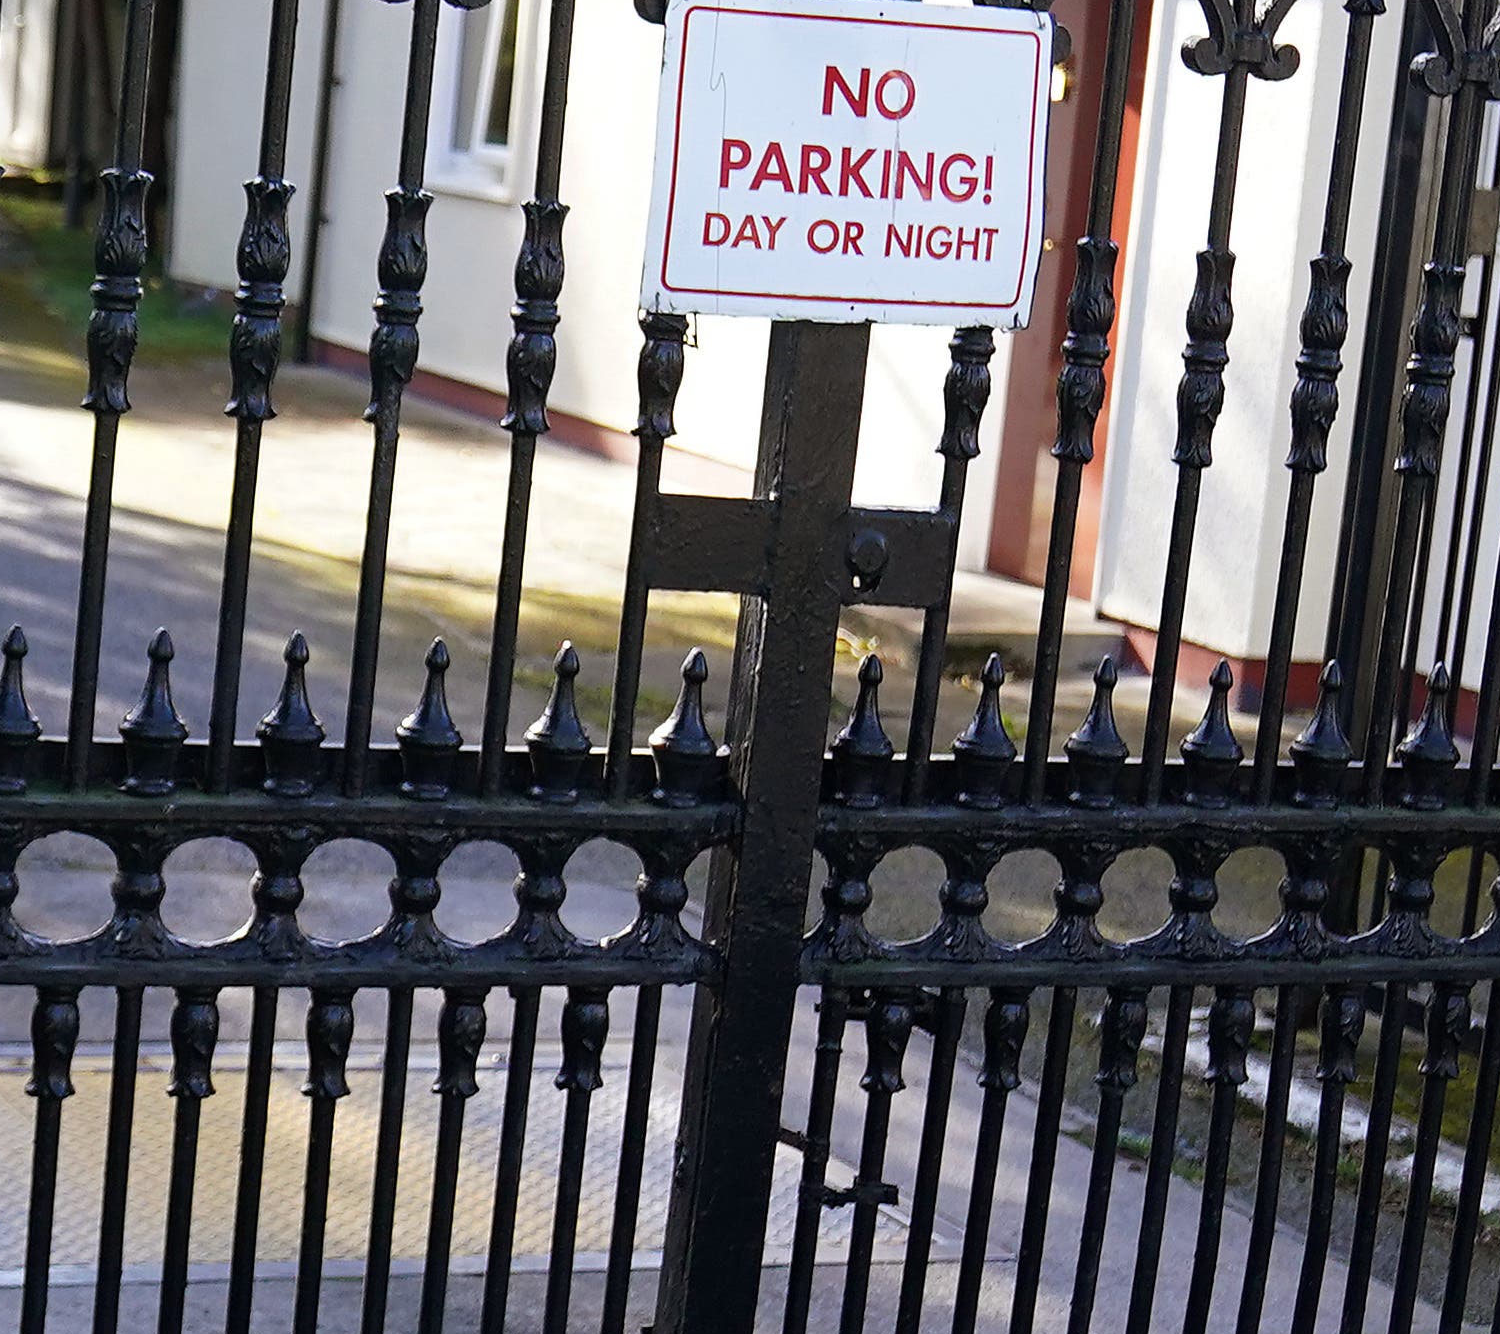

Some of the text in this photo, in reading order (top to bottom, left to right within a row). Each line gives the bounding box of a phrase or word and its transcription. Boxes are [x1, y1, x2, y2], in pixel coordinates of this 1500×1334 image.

[822, 65, 916, 120] NO
[719, 138, 994, 205] PARKING!
[702, 212, 999, 262] DAY OR NIGHT
